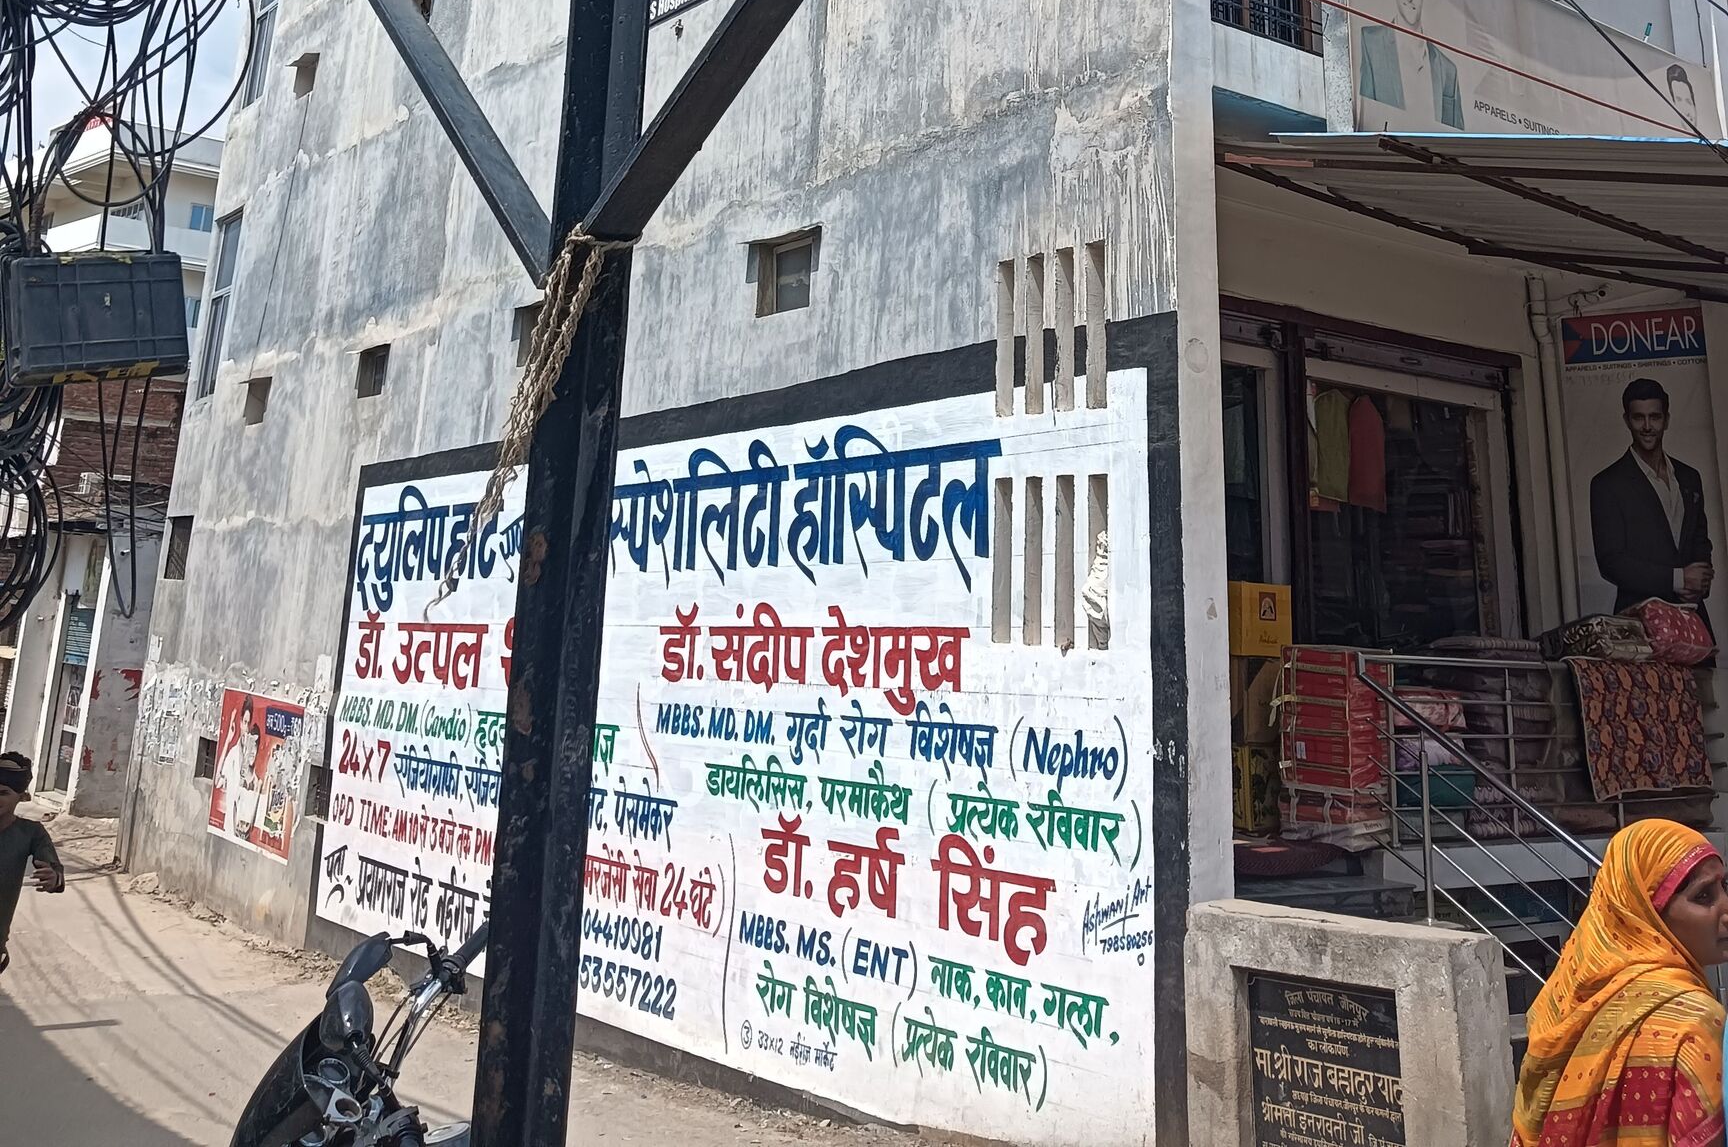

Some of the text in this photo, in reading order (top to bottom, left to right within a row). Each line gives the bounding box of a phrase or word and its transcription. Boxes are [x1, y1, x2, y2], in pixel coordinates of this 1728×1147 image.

[1473, 99, 1517, 125] APPARELS
[1590, 315, 1700, 356] DONEAR
[1677, 358, 1708, 366] COTTON
[787, 425, 1002, 593] हॉस्पिटल
[392, 622, 489, 691] उत्पल
[708, 602, 815, 694] संदीप
[821, 605, 970, 716] देशमुख
[742, 709, 775, 746] DM.
[840, 699, 893, 759] रोग
[1009, 715, 1128, 801] (Nephro)
[332, 793, 354, 826] OPD
[584, 843, 631, 908] मरजेंसी
[660, 862, 688, 920] 24
[827, 826, 905, 919] हर्ष
[930, 833, 1057, 967] सिंह
[1130, 875, 1152, 912] Art
[583, 908, 663, 963] 04419981
[795, 924, 836, 967] MS.
[840, 927, 918, 1001] (ENT)
[579, 954, 677, 1021] 53557222
[756, 959, 797, 1017] रोग
[1274, 1044, 1292, 1083] श्री
[1292, 1055, 1324, 1089] राज
[1374, 1072, 1404, 1108] याद
[1261, 1095, 1296, 1129] श्रीमती
[1347, 1116, 1365, 1146] जी
